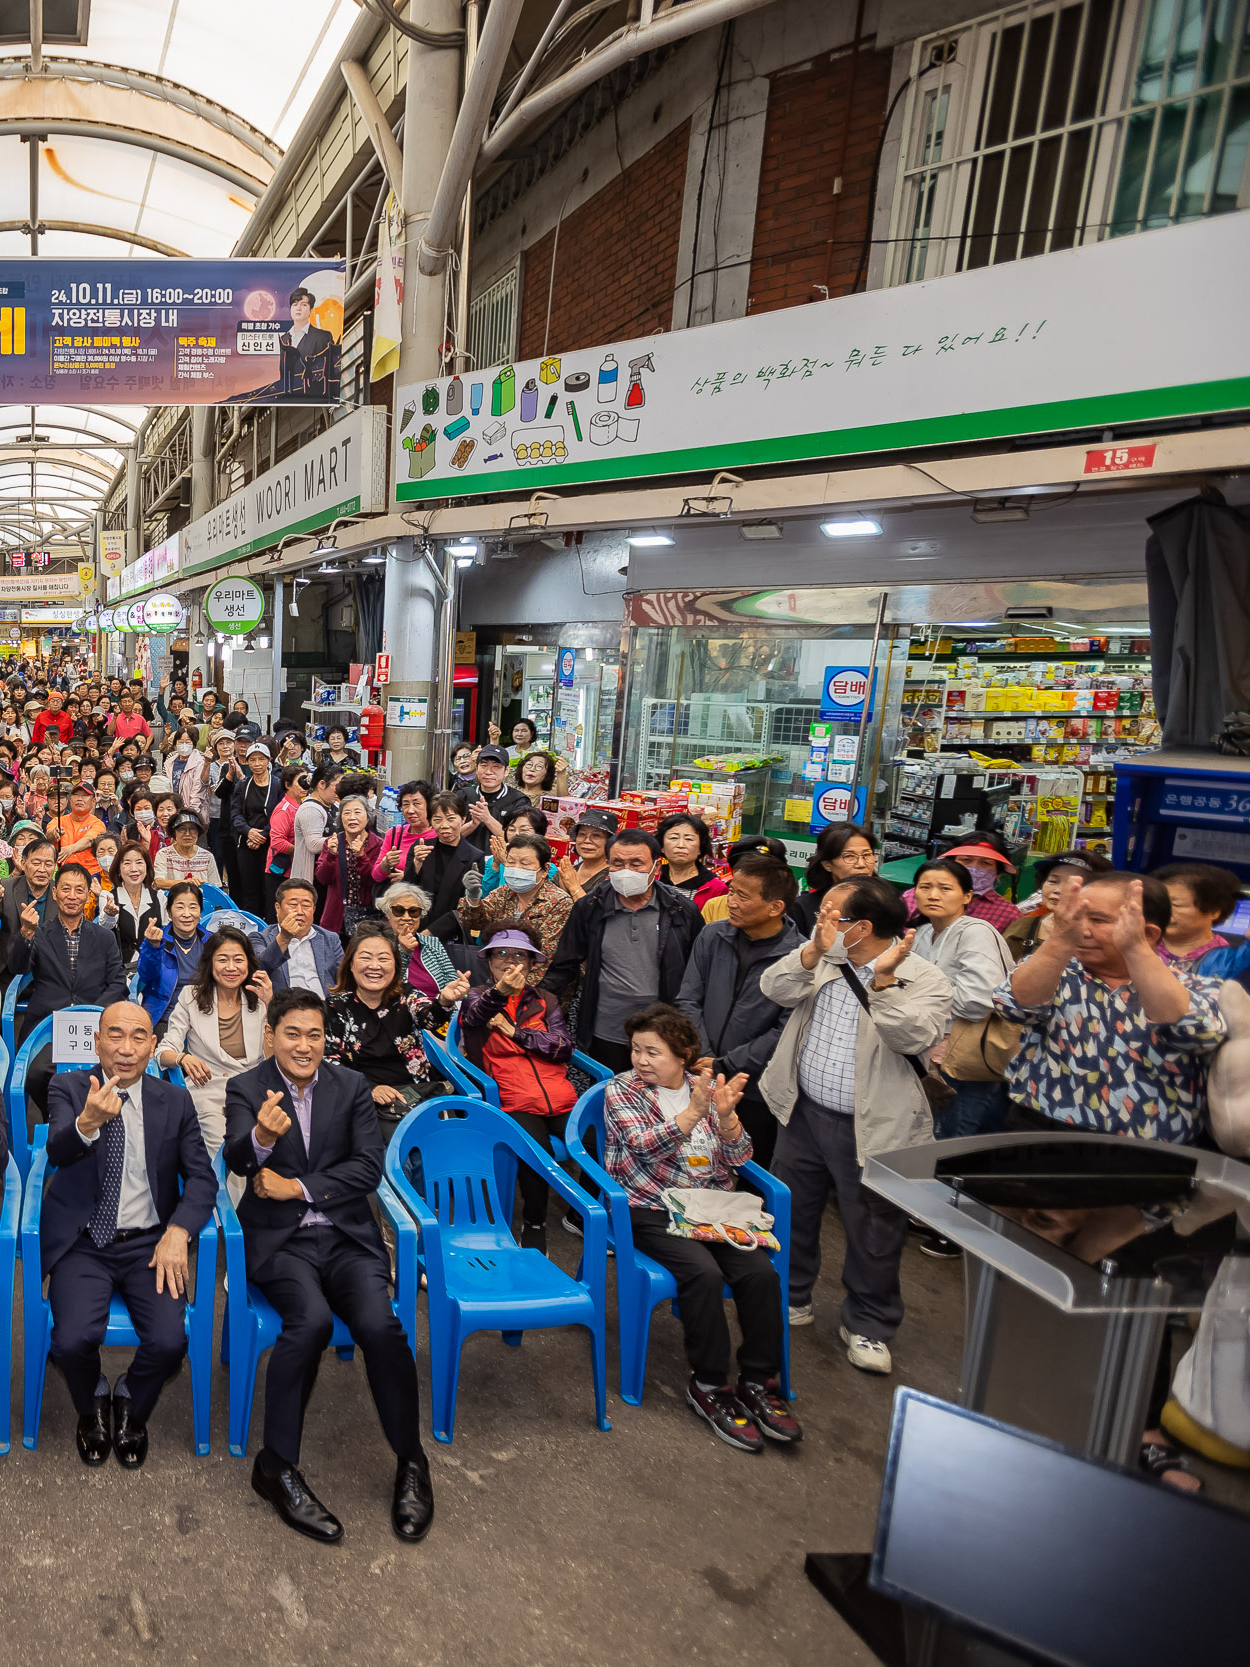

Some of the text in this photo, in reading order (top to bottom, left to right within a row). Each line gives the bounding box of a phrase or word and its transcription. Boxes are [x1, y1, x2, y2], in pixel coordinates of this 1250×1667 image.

[147, 288, 233, 304] 16:00~20:00
[51, 308, 178, 327] 자양전통시장 내
[53, 336, 72, 347] 고객
[73, 336, 92, 347] 감사
[121, 336, 140, 347] 행사
[178, 336, 216, 347] 맥주 축제
[690, 371, 748, 396] 상품의
[844, 346, 888, 373] 뭐든
[902, 344, 923, 358] 다
[1104, 448, 1129, 466] 15
[255, 470, 296, 524] WOORI
[304, 436, 352, 503] MART
[213, 589, 256, 603] 우리마트
[224, 603, 246, 617] 생선
[228, 622, 242, 631] 생선
[833, 680, 867, 695] 담배
[1165, 794, 1222, 808] 은행공동
